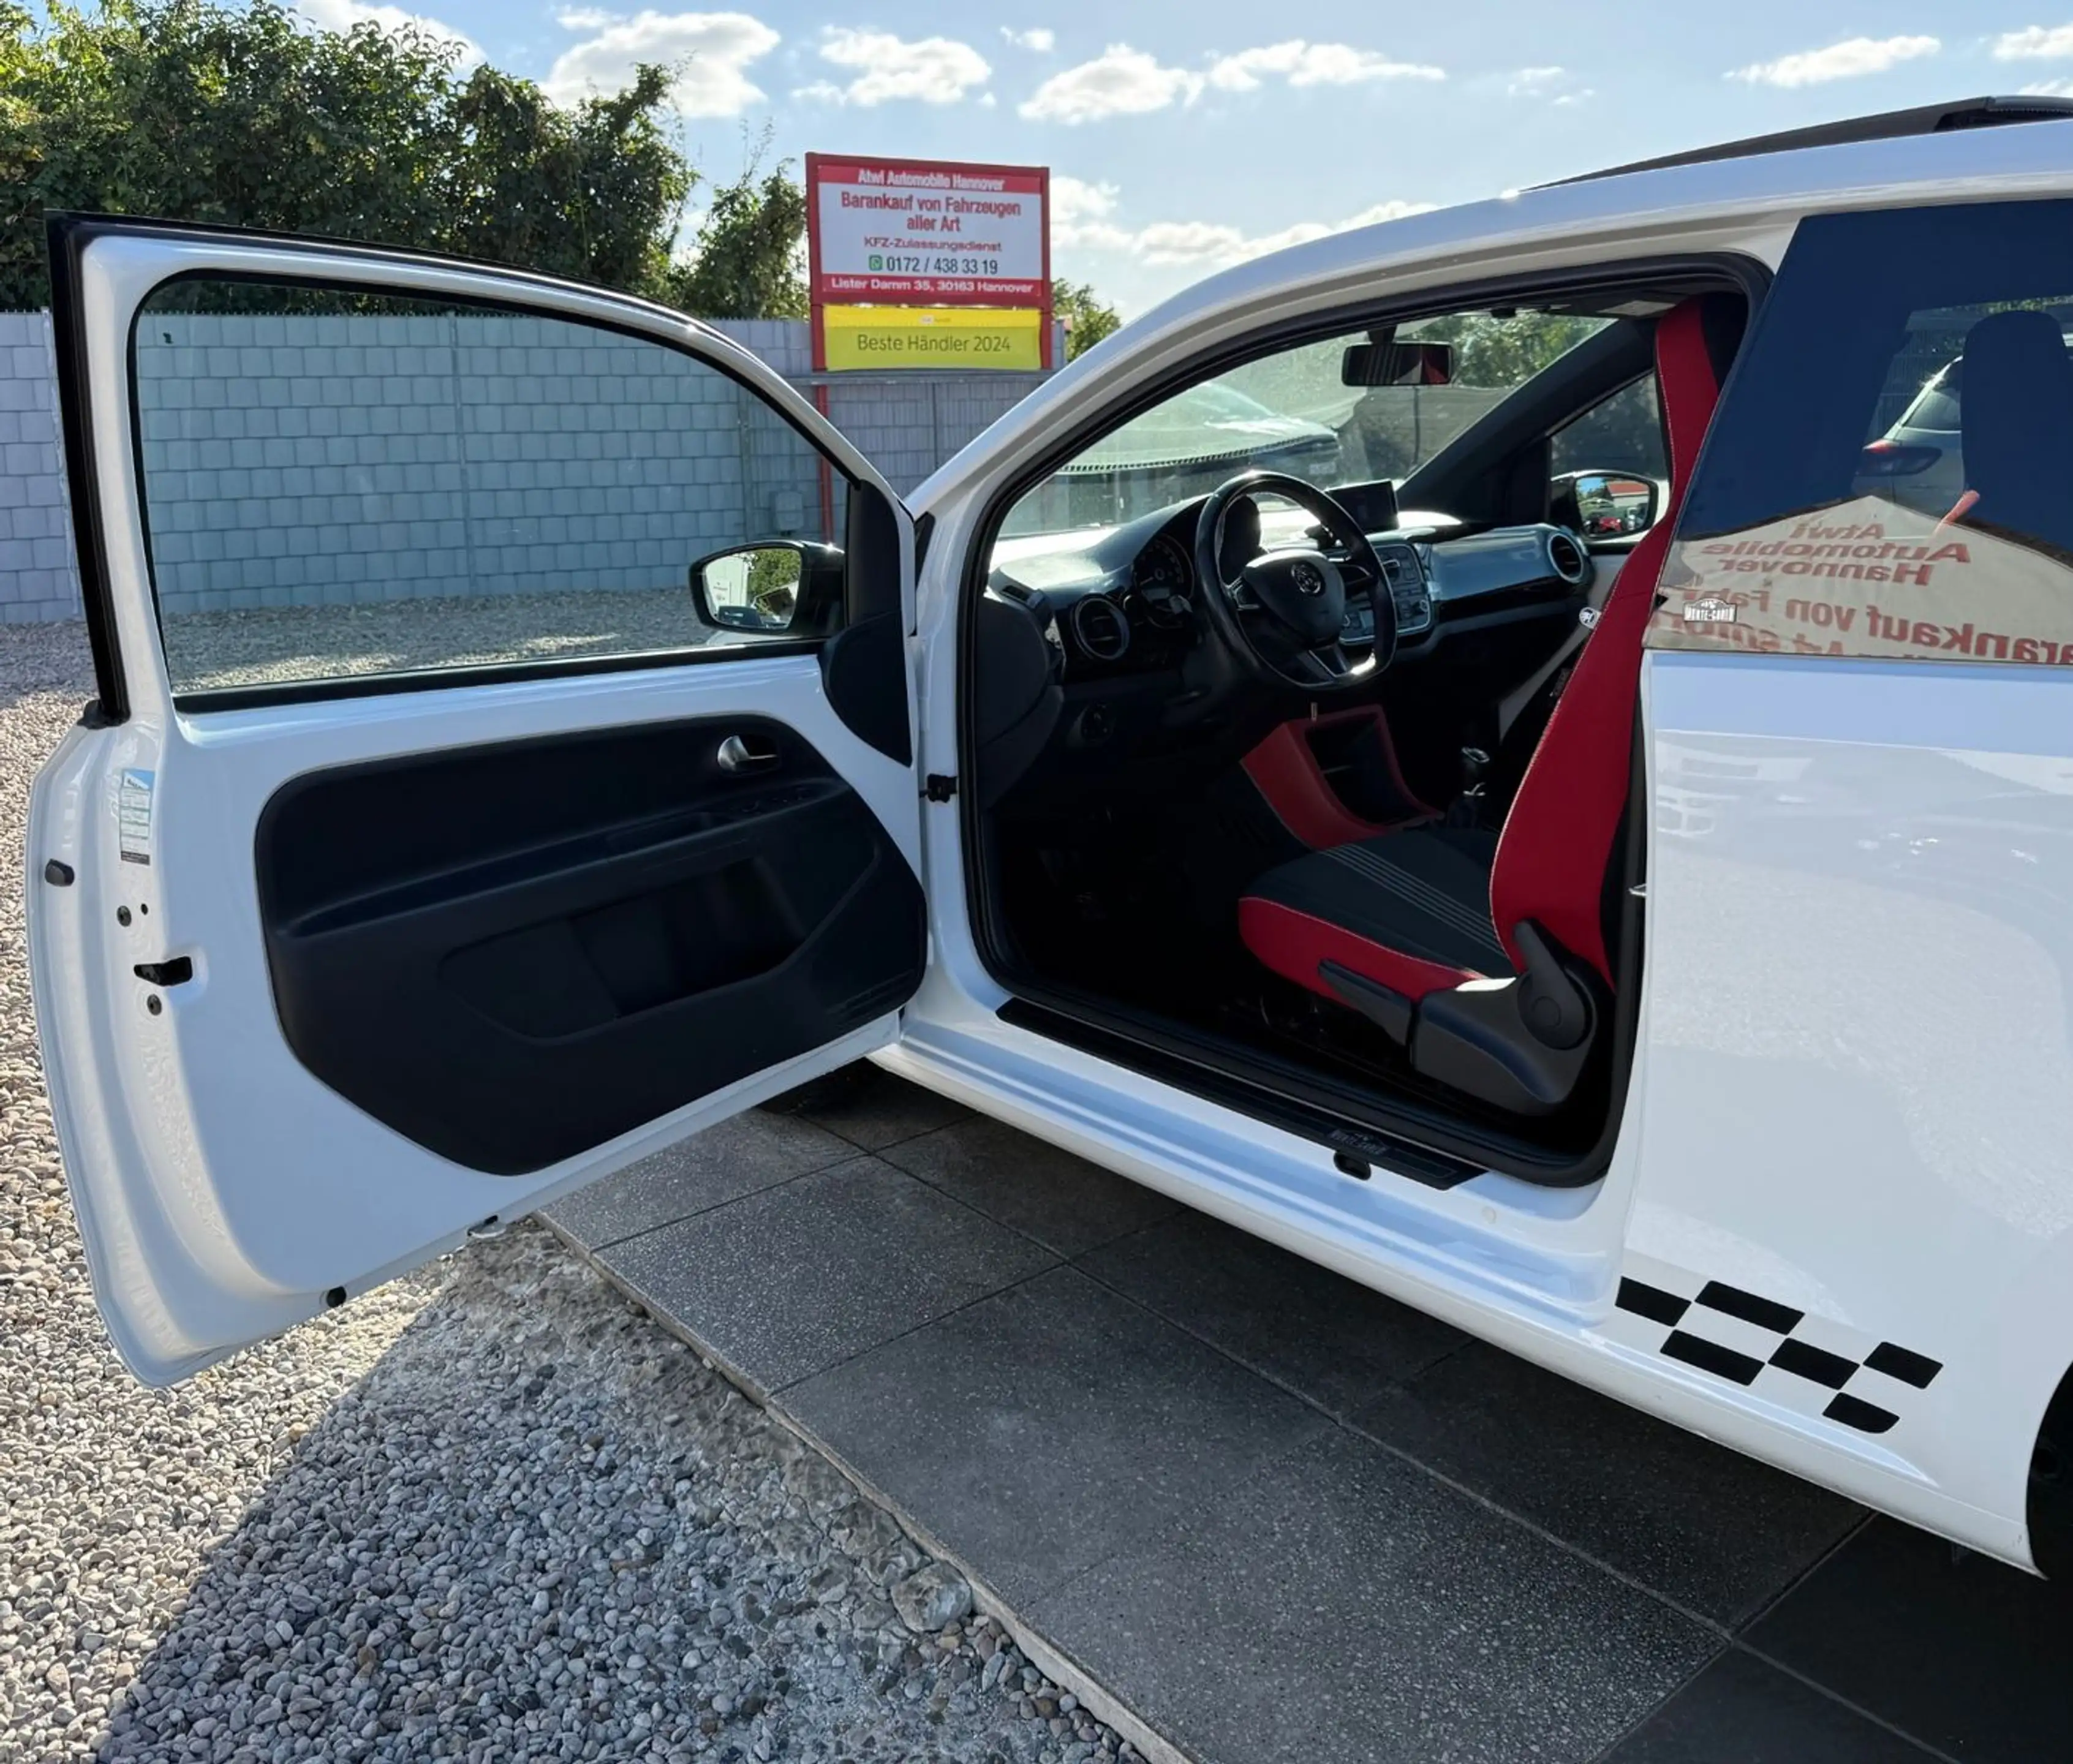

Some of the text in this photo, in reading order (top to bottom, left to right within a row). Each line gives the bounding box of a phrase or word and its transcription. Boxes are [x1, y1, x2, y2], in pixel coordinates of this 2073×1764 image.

[887, 170, 950, 188] Automobile
[952, 173, 1005, 190] Hannover
[841, 192, 1021, 218] Barankauf von Fahrzeugen
[907, 216, 961, 232] aller Art
[864, 236, 1002, 253] KFZ-Zulassungsdienst
[886, 256, 998, 274] 0172 / 438 33 19
[831, 277, 1033, 293] Lister Damm 35, 30163 Hannover
[857, 334, 1011, 352] Beste Händler 2024
